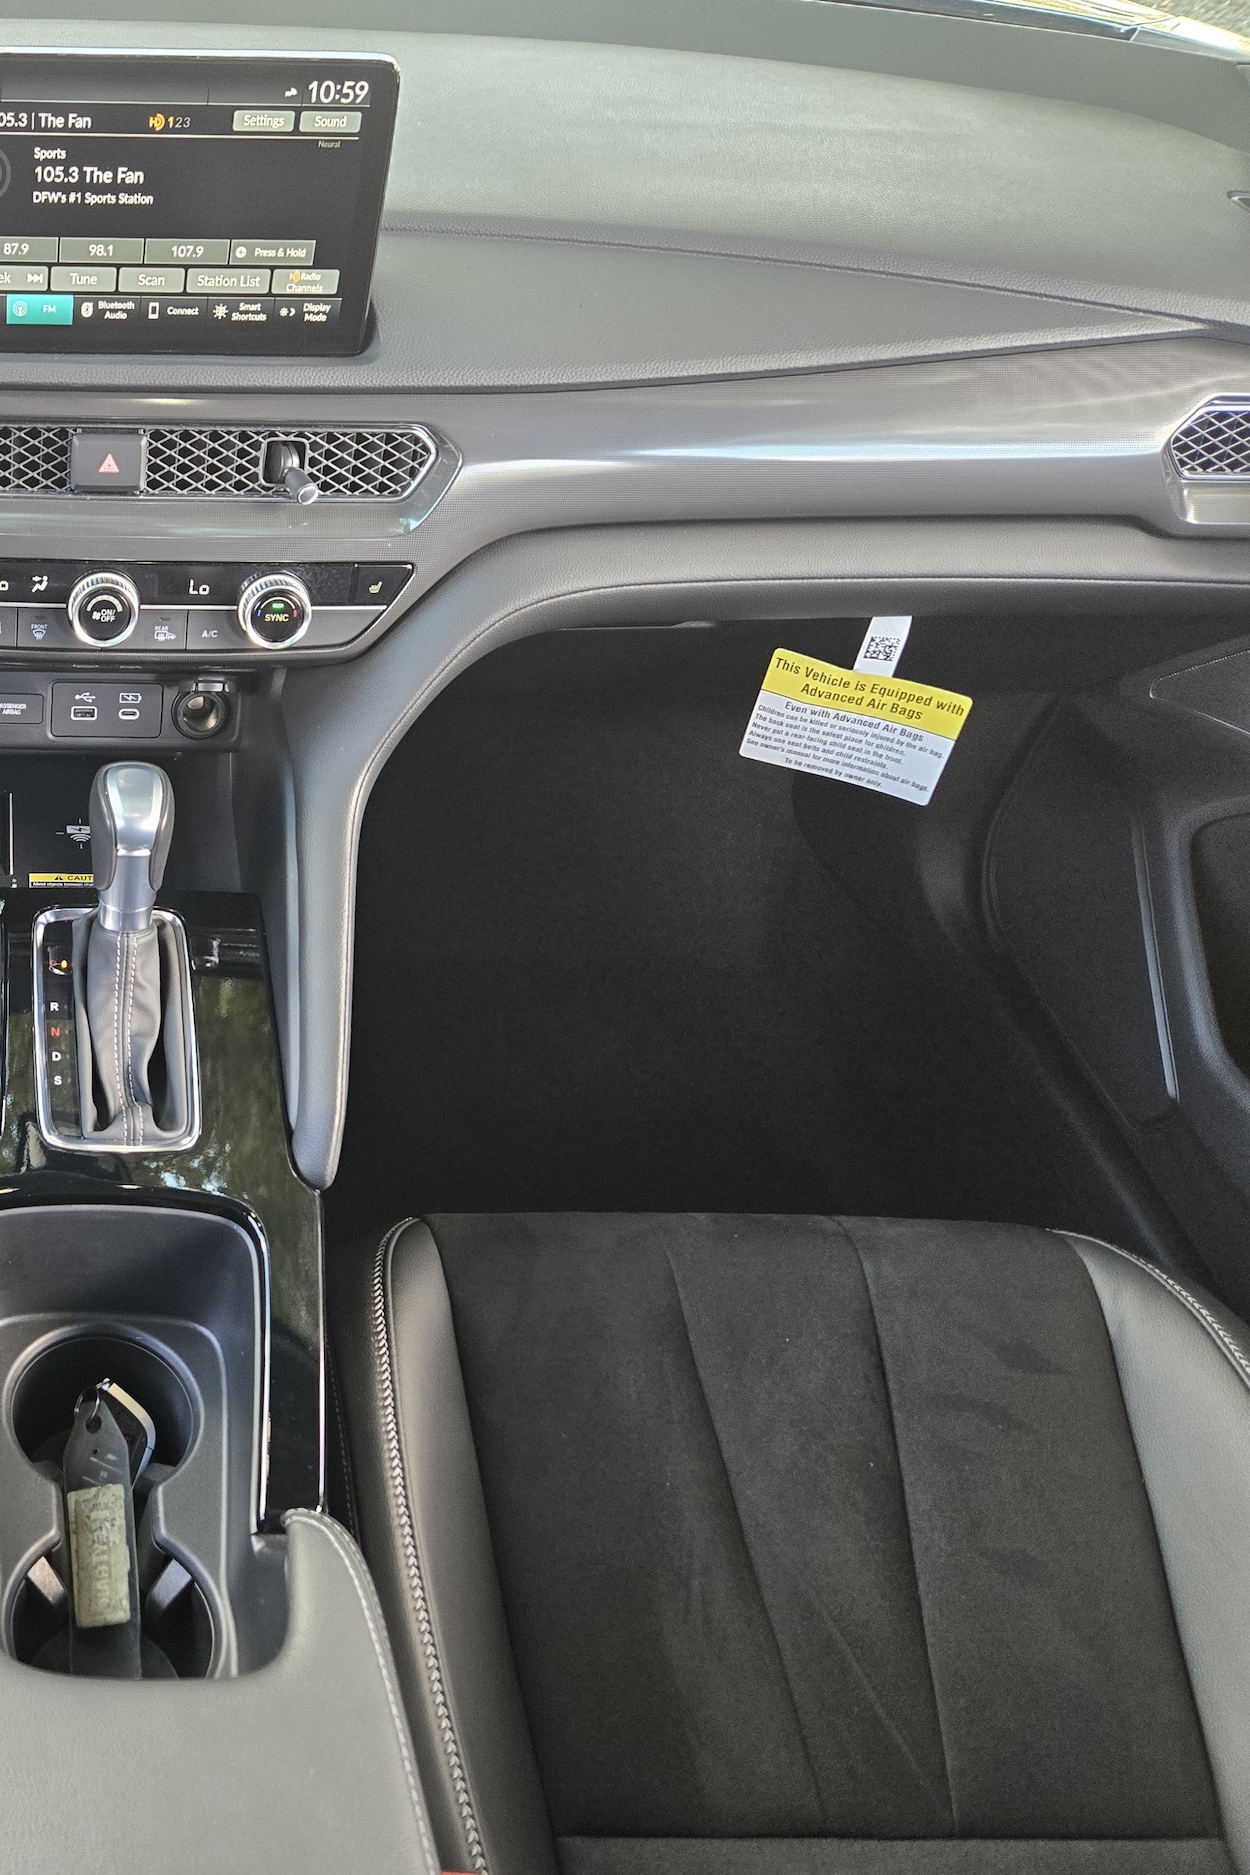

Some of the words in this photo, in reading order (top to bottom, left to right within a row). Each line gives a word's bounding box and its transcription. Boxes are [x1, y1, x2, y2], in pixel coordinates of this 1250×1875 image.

[307, 80, 369, 104] 10:59
[38, 112, 65, 128] The
[67, 113, 92, 129] Fan
[243, 114, 285, 128] Settings
[314, 116, 347, 128] Sound
[317, 140, 341, 148] Neural
[33, 147, 67, 161] Sports
[34, 166, 80, 183] 105.3
[83, 166, 113, 184] The
[116, 167, 144, 184] Fan
[32, 192, 67, 204] DFW's
[69, 192, 82, 204] #1
[84, 192, 116, 206] Sports
[118, 193, 154, 205] Station
[3, 243, 30, 256] 87.9
[89, 244, 114, 257] 98.1
[171, 245, 204, 259] 107.9
[254, 247, 277, 258] Press
[286, 248, 307, 258] Hold
[70, 273, 98, 286] Tune
[138, 274, 166, 286] Scan
[197, 275, 237, 287] Station
[240, 275, 261, 288] List
[301, 273, 322, 281] Radio
[286, 284, 324, 293] Channels
[43, 304, 56, 313] FM
[98, 301, 135, 310] Bluetooth
[167, 306, 199, 316] Connect
[239, 303, 262, 311] Smart
[303, 303, 331, 313] Display
[104, 311, 128, 320] Audio
[231, 313, 267, 321] Shortcuts
[304, 314, 327, 322] Mode
[189, 579, 210, 595] Lo
[264, 613, 289, 622] SYNC
[202, 630, 218, 638] A/C
[775, 657, 801, 675] This
[805, 666, 851, 689] Vehicle
[854, 681, 867, 691] is
[870, 683, 933, 707] Equipped
[936, 700, 964, 716] with
[800, 683, 864, 706] Advanced
[866, 698, 888, 710] Air
[890, 703, 923, 720] Bags
[755, 713, 767, 722] The
[768, 717, 784, 727] back
[785, 722, 801, 730] seat
[822, 730, 843, 740] safest
[784, 701, 808, 714] Even
[810, 709, 831, 719] with
[832, 712, 881, 730] Advanced
[882, 724, 898, 734] Air
[899, 729, 924, 741] Bags
[752, 721, 771, 732] Never
[829, 741, 847, 749] child
[758, 705, 785, 718] Children
[809, 719, 829, 728] killed
[839, 724, 870, 737] seriously
[870, 731, 895, 743] injured
[906, 741, 917, 749] the
[918, 745, 928, 753] air
[749, 730, 772, 741] Always
[803, 743, 820, 752] belts
[835, 751, 853, 760] child
[746, 738, 759, 746] See
[822, 757, 840, 765] more
[841, 760, 880, 775] information
[880, 771, 900, 781] about
[900, 777, 910, 785] air
[804, 763, 834, 774] removed
[844, 773, 865, 782] owner
[50, 1002, 59, 1011] R
[51, 1027, 60, 1036] N
[52, 1051, 62, 1062] D
[54, 1076, 62, 1086] S
